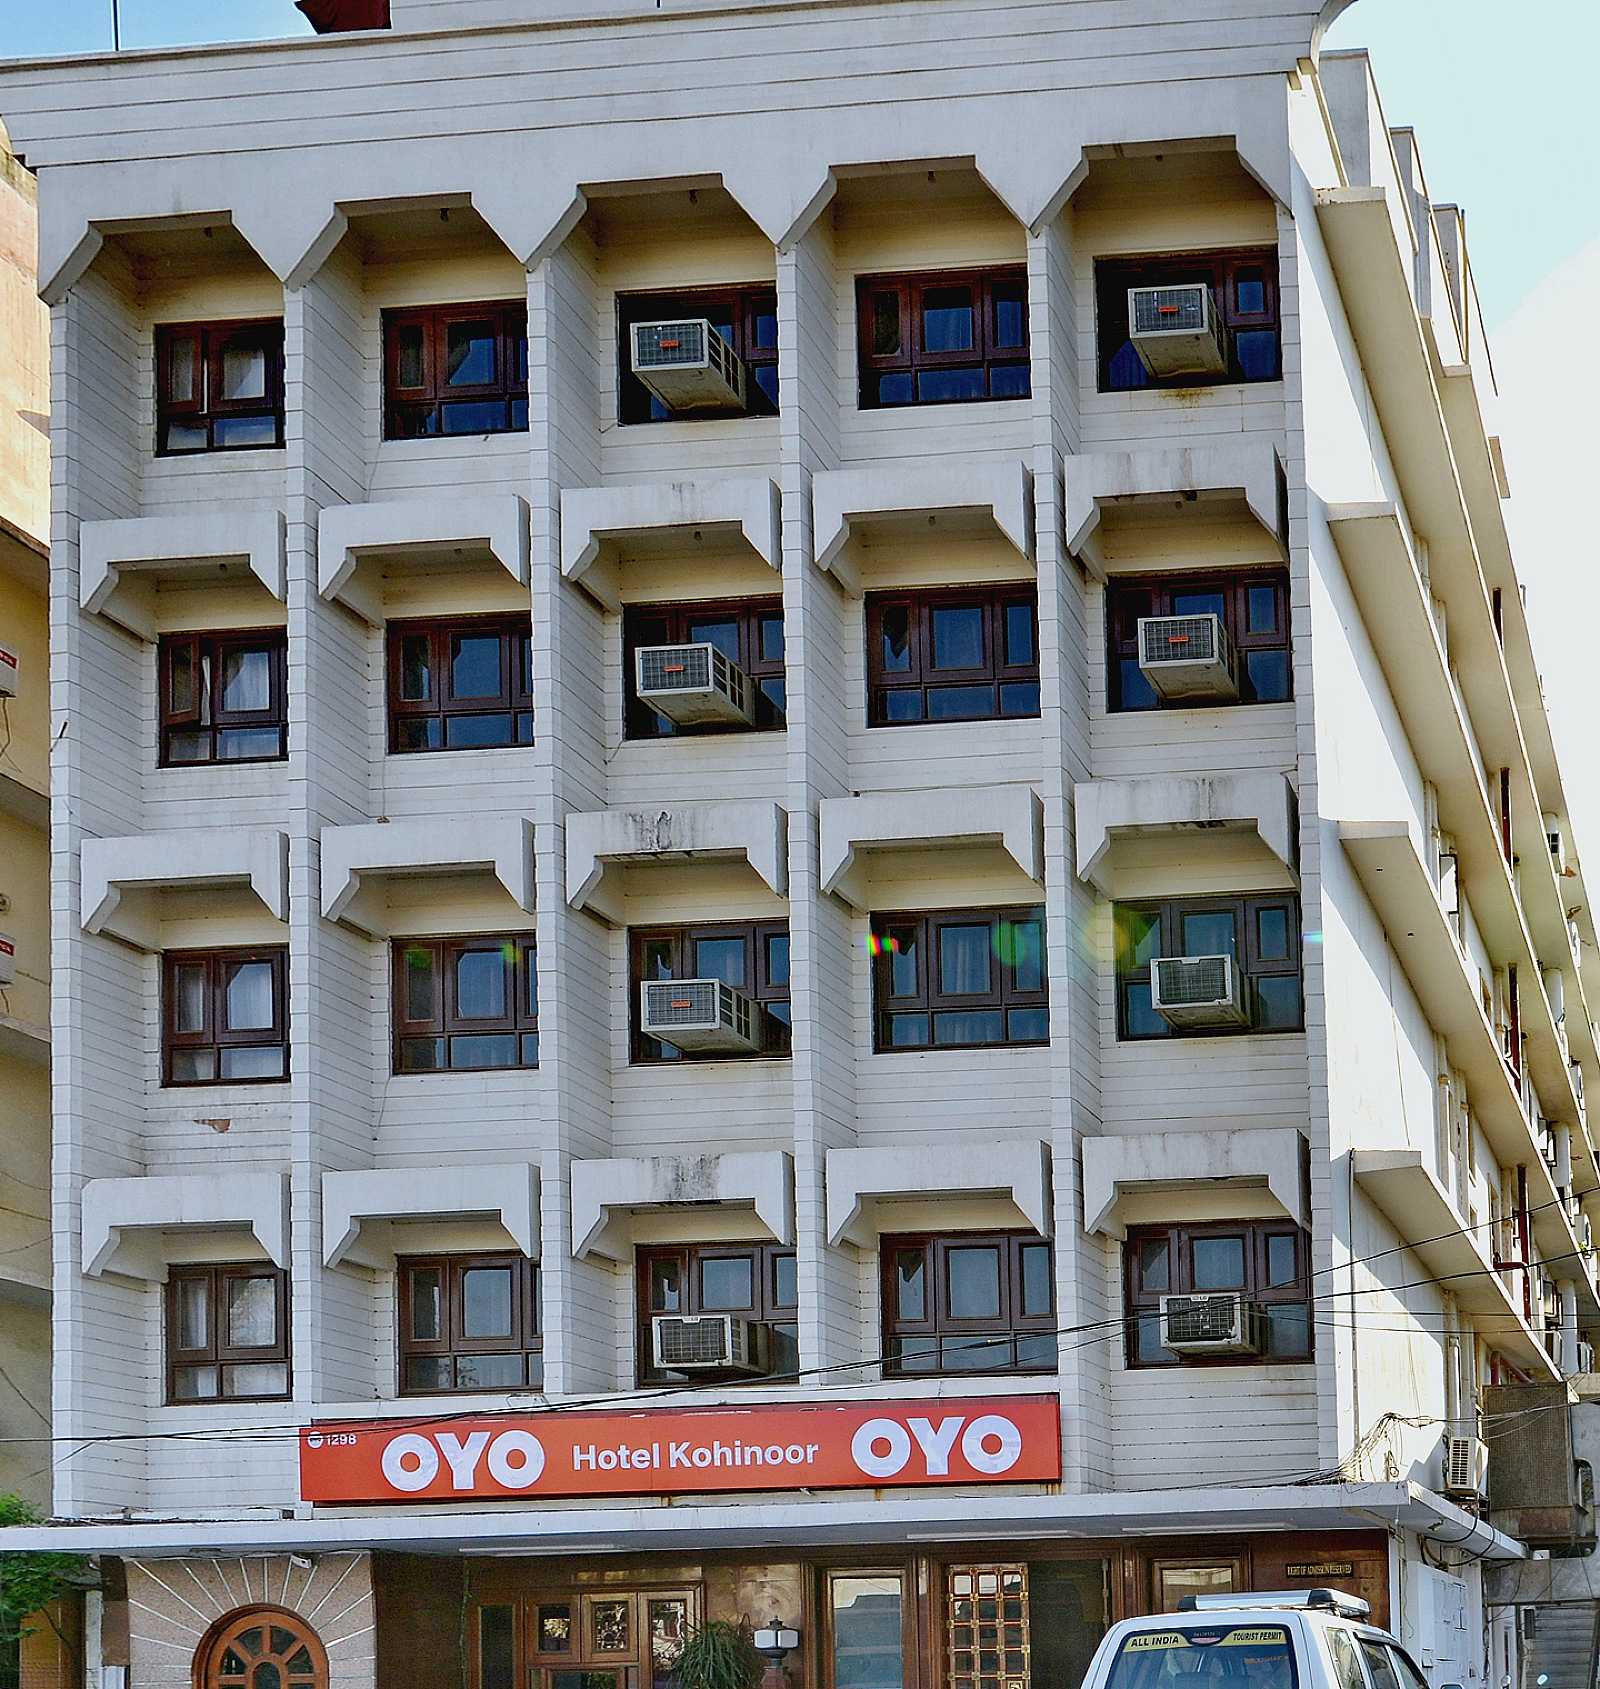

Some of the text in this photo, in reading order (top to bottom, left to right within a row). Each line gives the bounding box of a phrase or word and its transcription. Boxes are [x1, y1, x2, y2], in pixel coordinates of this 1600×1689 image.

[327, 1434, 357, 1446] 1298
[851, 1415, 1022, 1478] OYO
[381, 1429, 545, 1492] OYO
[573, 1440, 818, 1470] Hotel Kohinoor
[1131, 1636, 1179, 1647] ALL INDIA
[1233, 1631, 1283, 1641] TOURIST PERMIT
